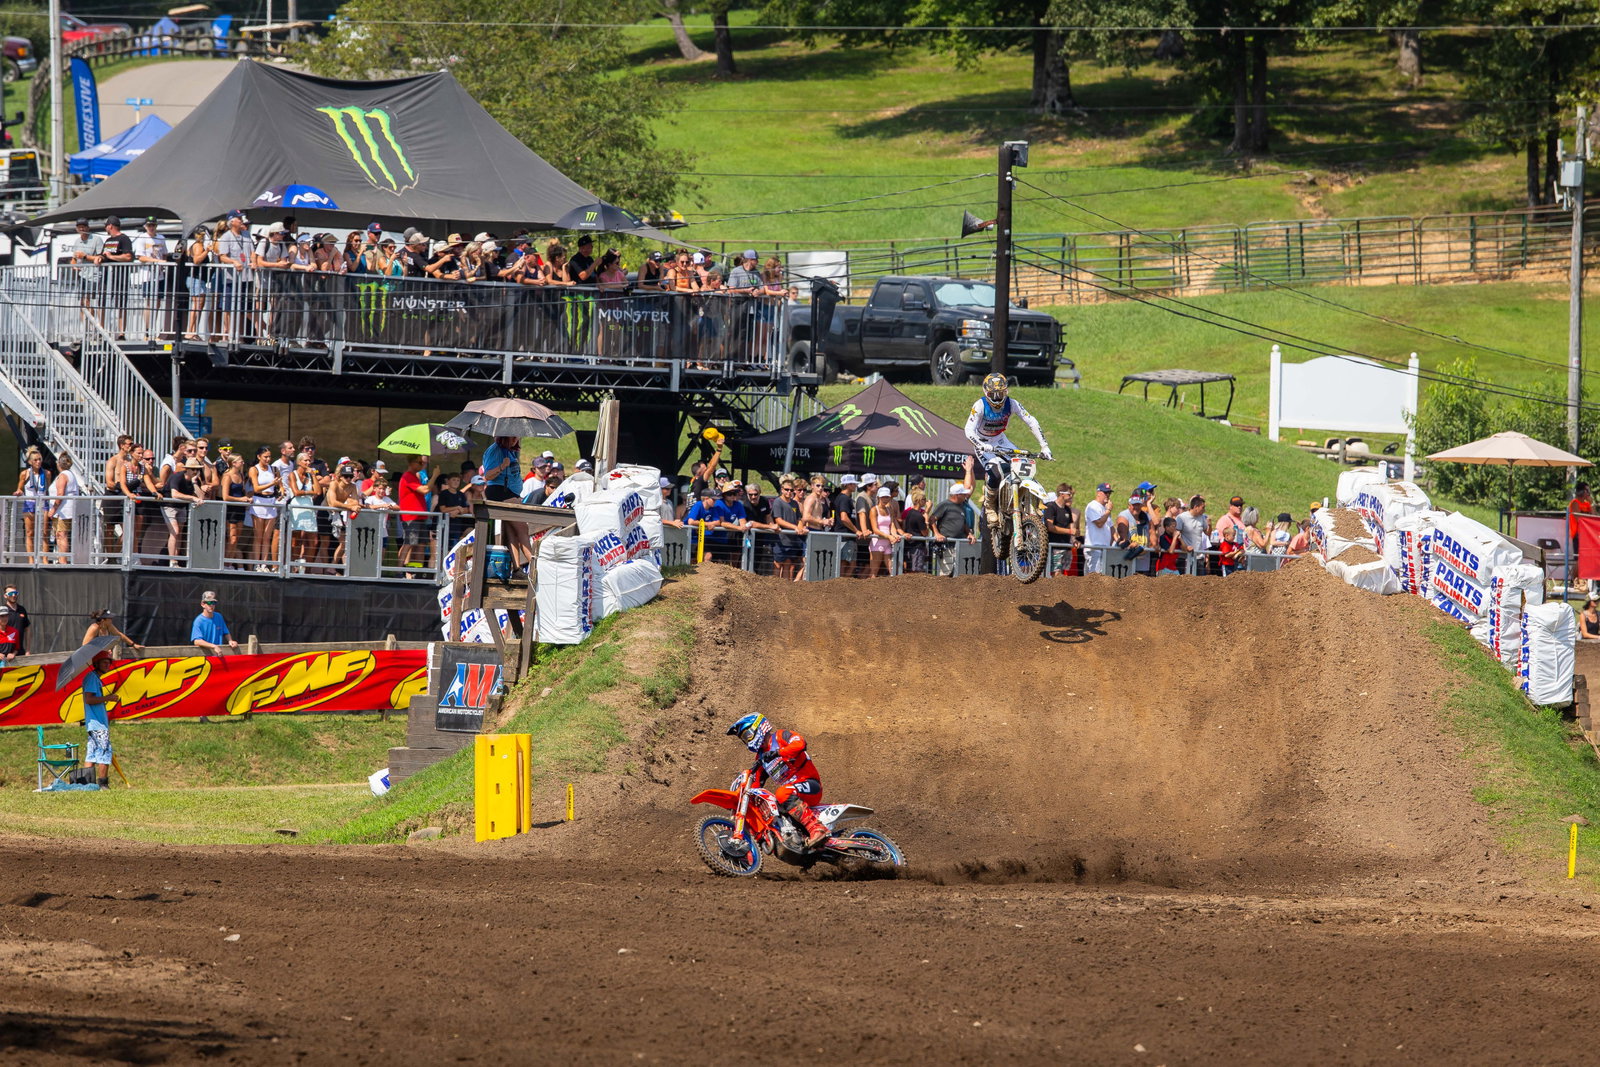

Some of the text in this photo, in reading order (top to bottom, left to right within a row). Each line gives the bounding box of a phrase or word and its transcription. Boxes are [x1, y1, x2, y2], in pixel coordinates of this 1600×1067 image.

[79, 76, 95, 150] OGRESSIVE
[392, 295, 467, 314] MONSTER
[598, 307, 671, 324] MONSTER
[769, 445, 811, 459] MOTER
[909, 450, 968, 464] MONSTER
[918, 464, 962, 472] ENERGY
[1019, 462, 1032, 477] 5
[1433, 528, 1480, 571] PARTS
[1433, 544, 1478, 580] UNLIMITED
[1433, 576, 1479, 615] UNLIMITED
[1436, 561, 1483, 606] PARTS
[231, 651, 372, 715] FMF
